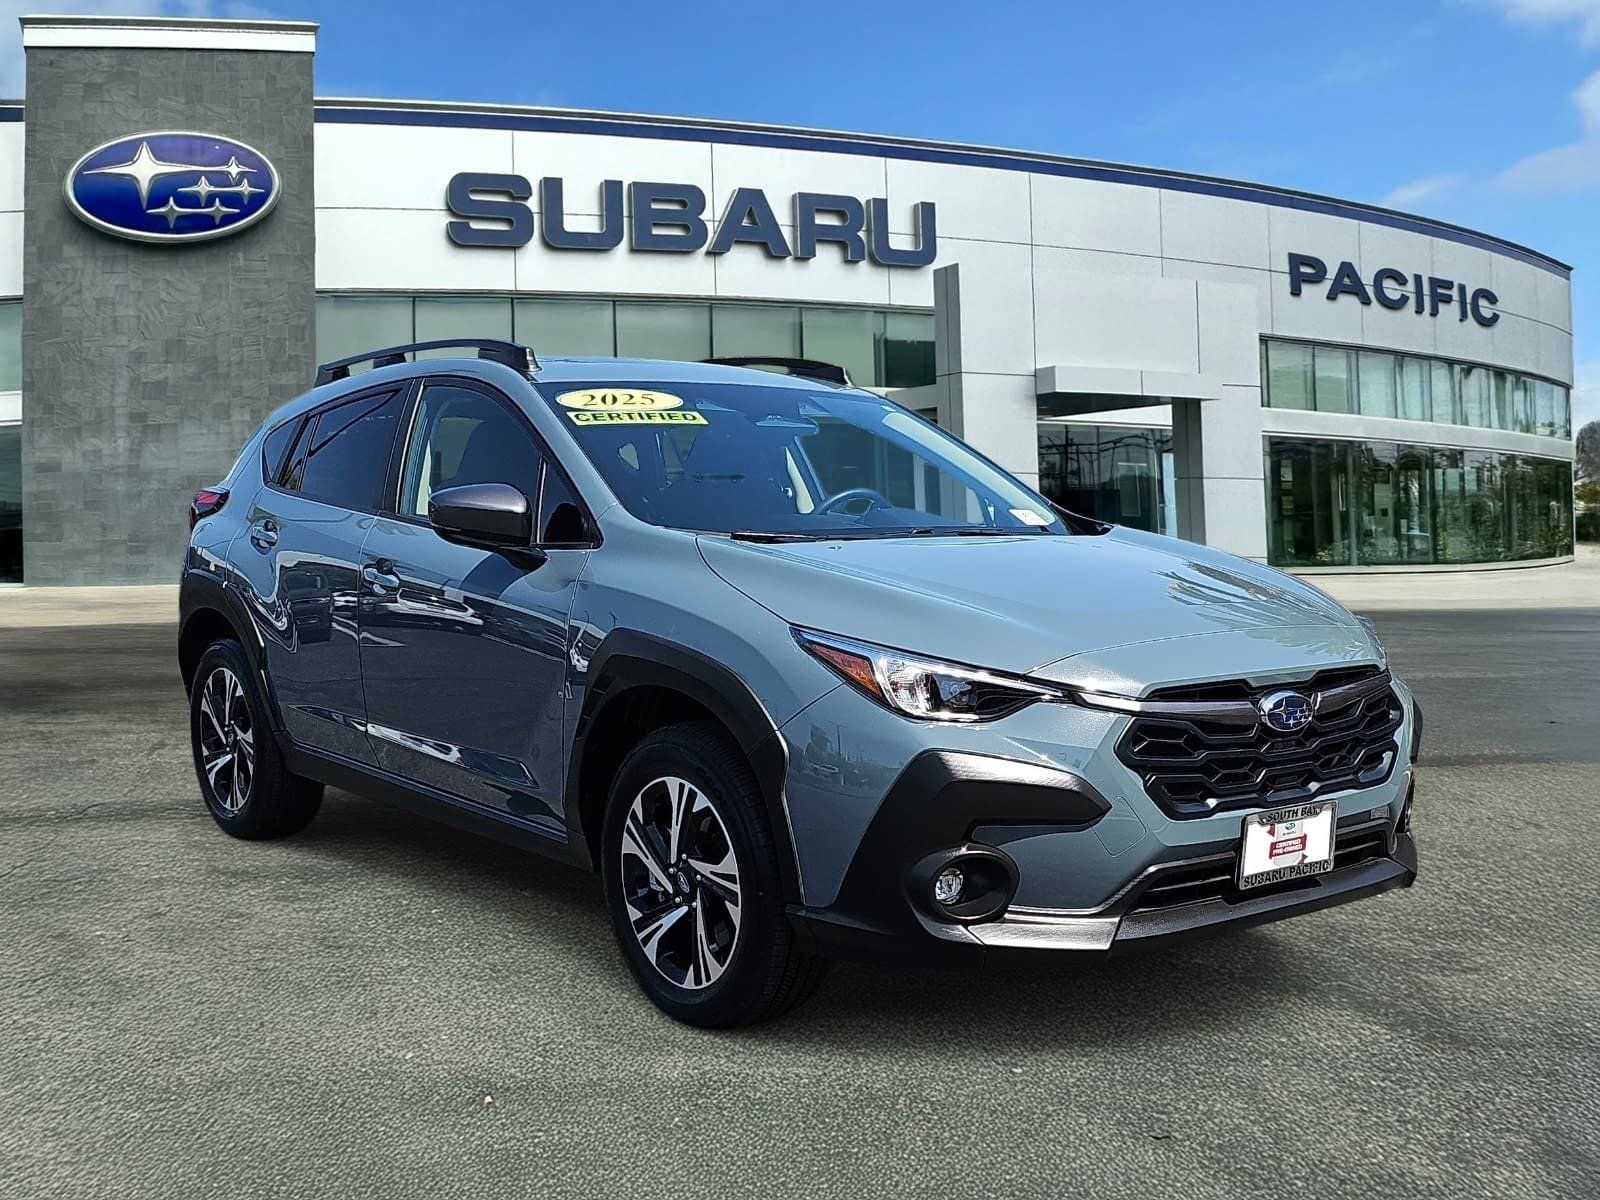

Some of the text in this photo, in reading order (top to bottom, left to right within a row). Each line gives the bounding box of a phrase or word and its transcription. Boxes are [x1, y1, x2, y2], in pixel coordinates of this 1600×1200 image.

[447, 171, 937, 267] SUBARU
[1288, 252, 1500, 327] PACIFIC
[581, 393, 655, 406] 2025
[574, 412, 697, 422] CERTIFIED
[1267, 805, 1320, 822] SOUTH BAY
[1243, 860, 1331, 888] SUBARU PACIFIC
